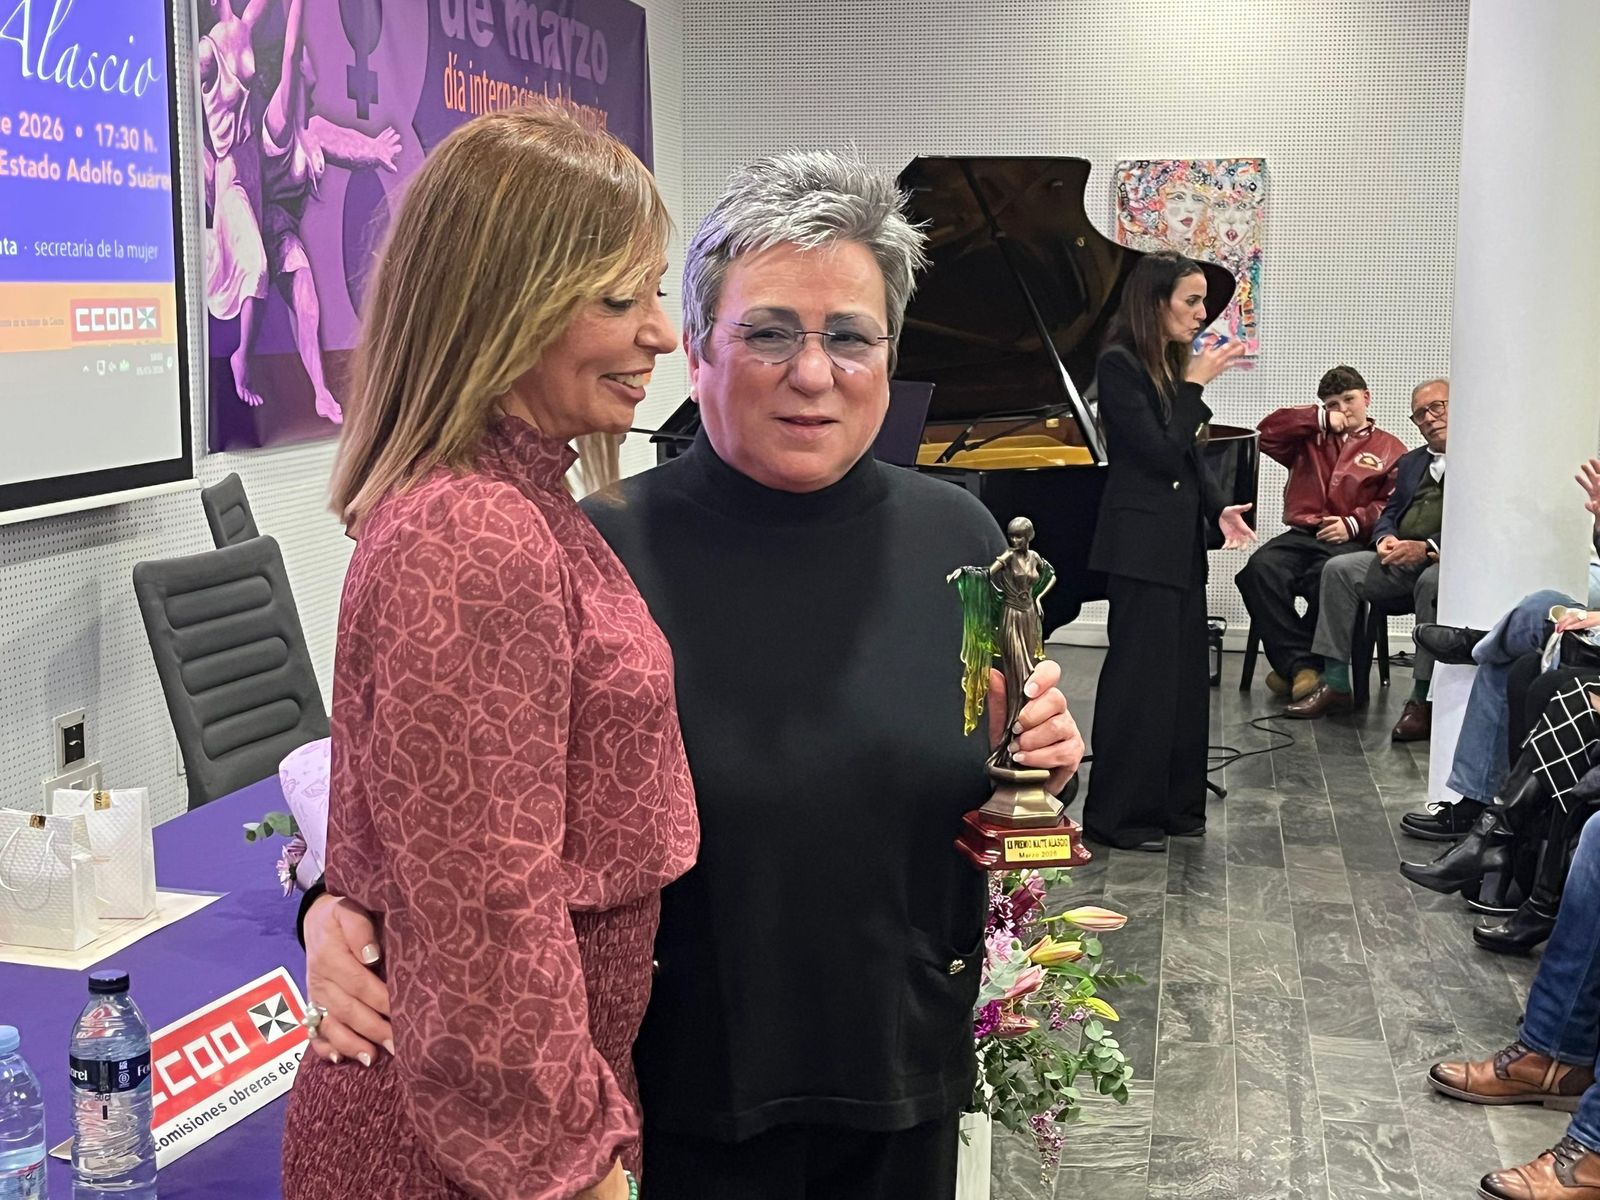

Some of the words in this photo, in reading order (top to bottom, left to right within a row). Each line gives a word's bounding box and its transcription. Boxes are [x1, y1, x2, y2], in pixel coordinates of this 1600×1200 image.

[0, 0, 161, 97] Alascio
[504, 0, 608, 85] marzo
[444, 51, 466, 112] día
[18, 111, 64, 142] 2026
[95, 123, 139, 151] 17:30
[144, 130, 157, 152] h.
[0, 149, 61, 180] Estado
[67, 157, 123, 186] Adolfo
[34, 238, 94, 257] secretaría
[97, 239, 111, 257] de
[114, 239, 124, 258] la
[127, 243, 158, 263] mujer
[75, 307, 134, 332] CCOO
[154, 1101, 228, 1152] comisiones
[228, 1071, 278, 1106] obreras
[278, 1061, 295, 1076] de
